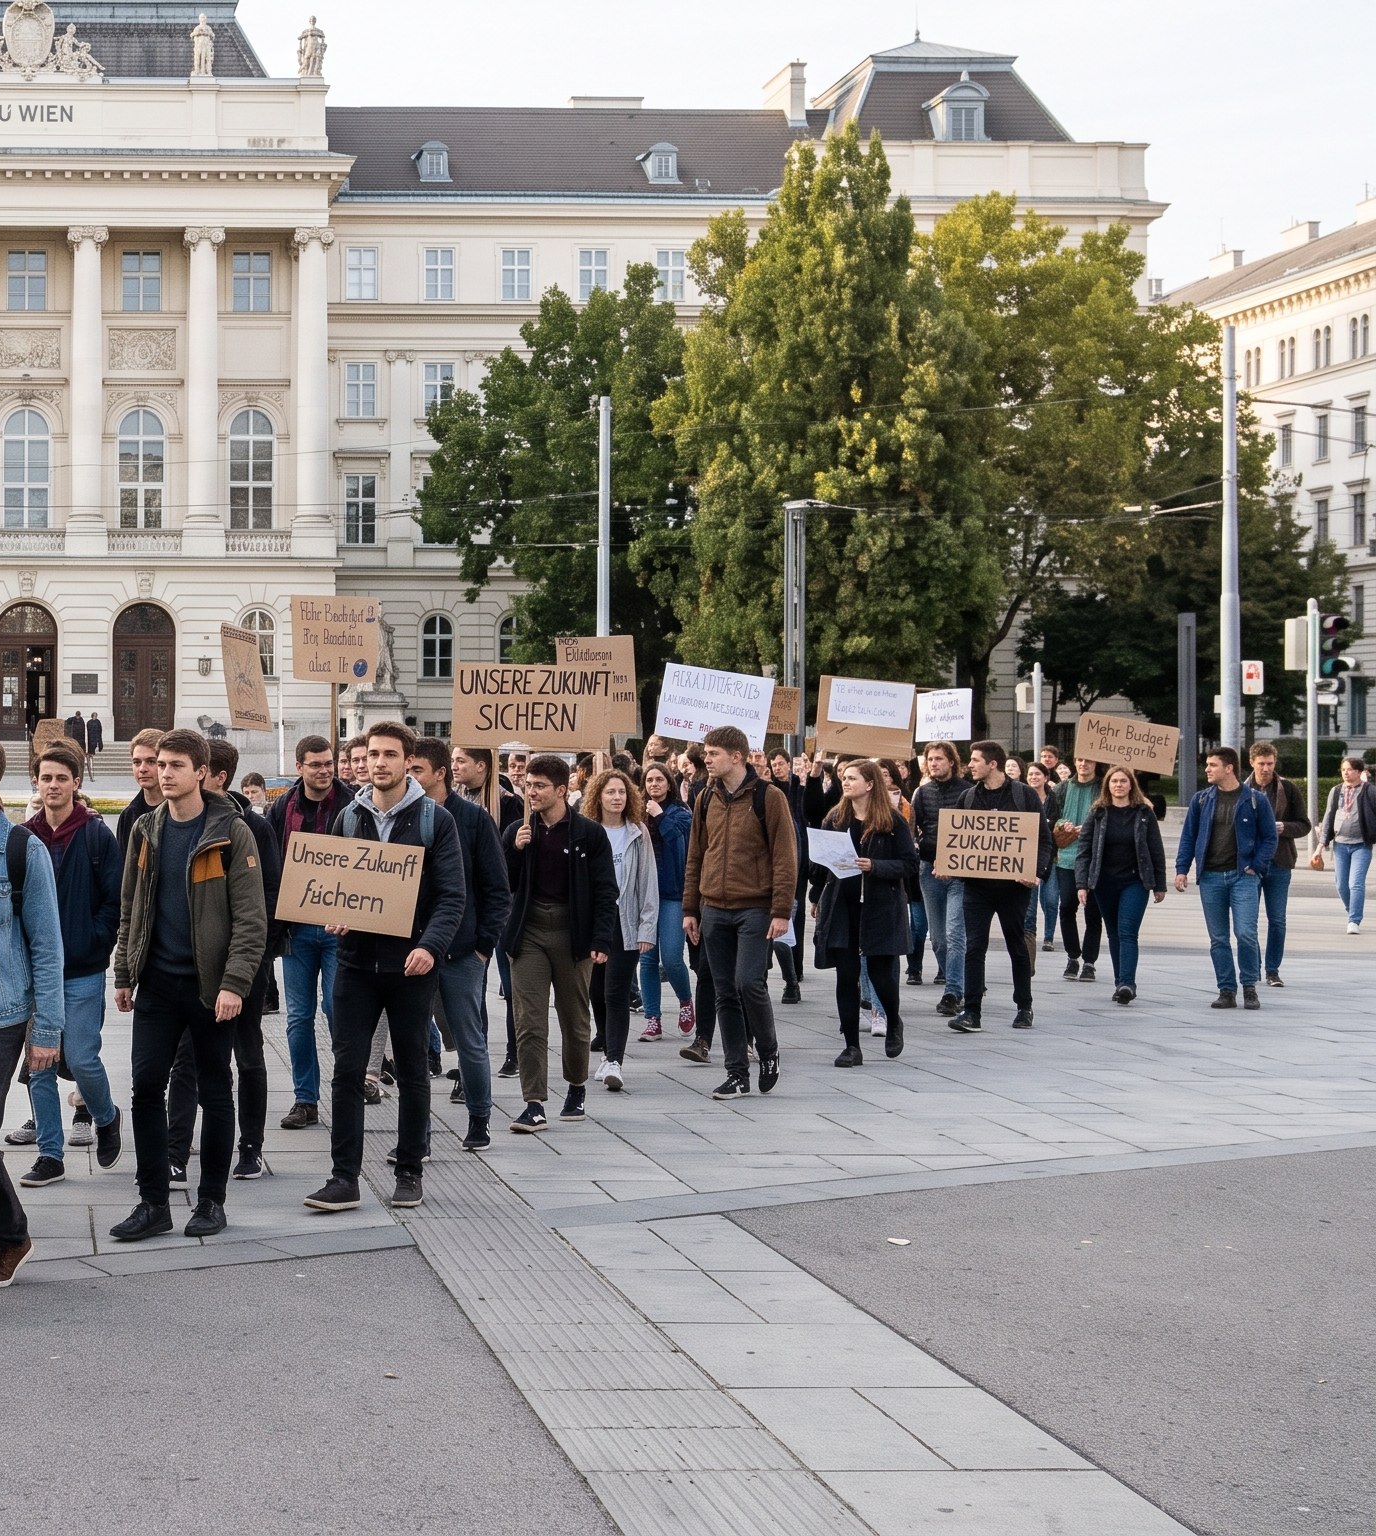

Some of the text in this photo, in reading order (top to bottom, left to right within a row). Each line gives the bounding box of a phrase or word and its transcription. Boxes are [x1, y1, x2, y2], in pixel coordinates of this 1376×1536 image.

[18, 104, 73, 122] WIEN
[460, 669, 611, 696] UNSERE ZUKUNFT
[475, 702, 577, 732] SICHERN
[1087, 719, 1170, 748] Mehr Budget
[951, 814, 1020, 833] UNSERE
[292, 841, 349, 868] Unsere
[946, 834, 1027, 853] ZUKUNFT
[947, 854, 1024, 874] SICHERN
